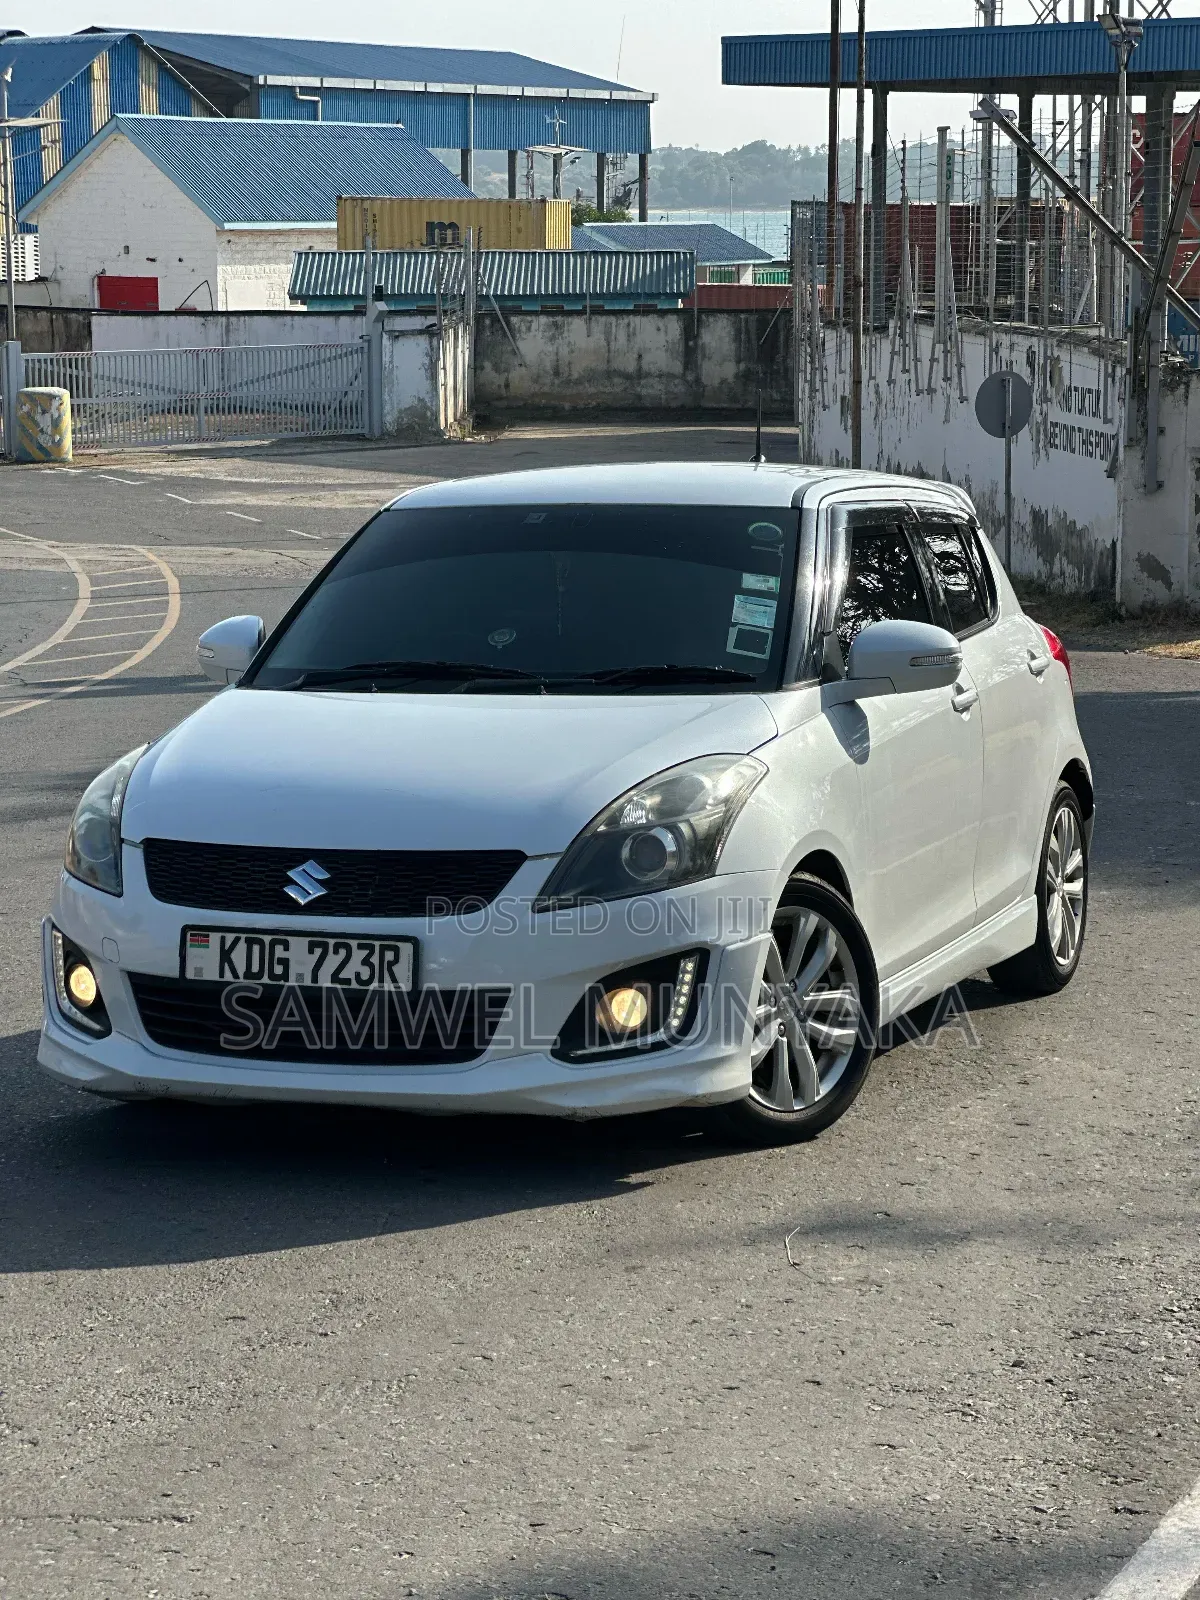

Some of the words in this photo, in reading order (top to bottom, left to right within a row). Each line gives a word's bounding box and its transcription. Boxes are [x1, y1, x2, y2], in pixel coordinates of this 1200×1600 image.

[1074, 386, 1102, 419] TUKTUK
[1049, 420, 1077, 455] BEYOND
[1077, 426, 1095, 458] THIS
[218, 935, 290, 983] KDG
[307, 940, 402, 989] 723R
